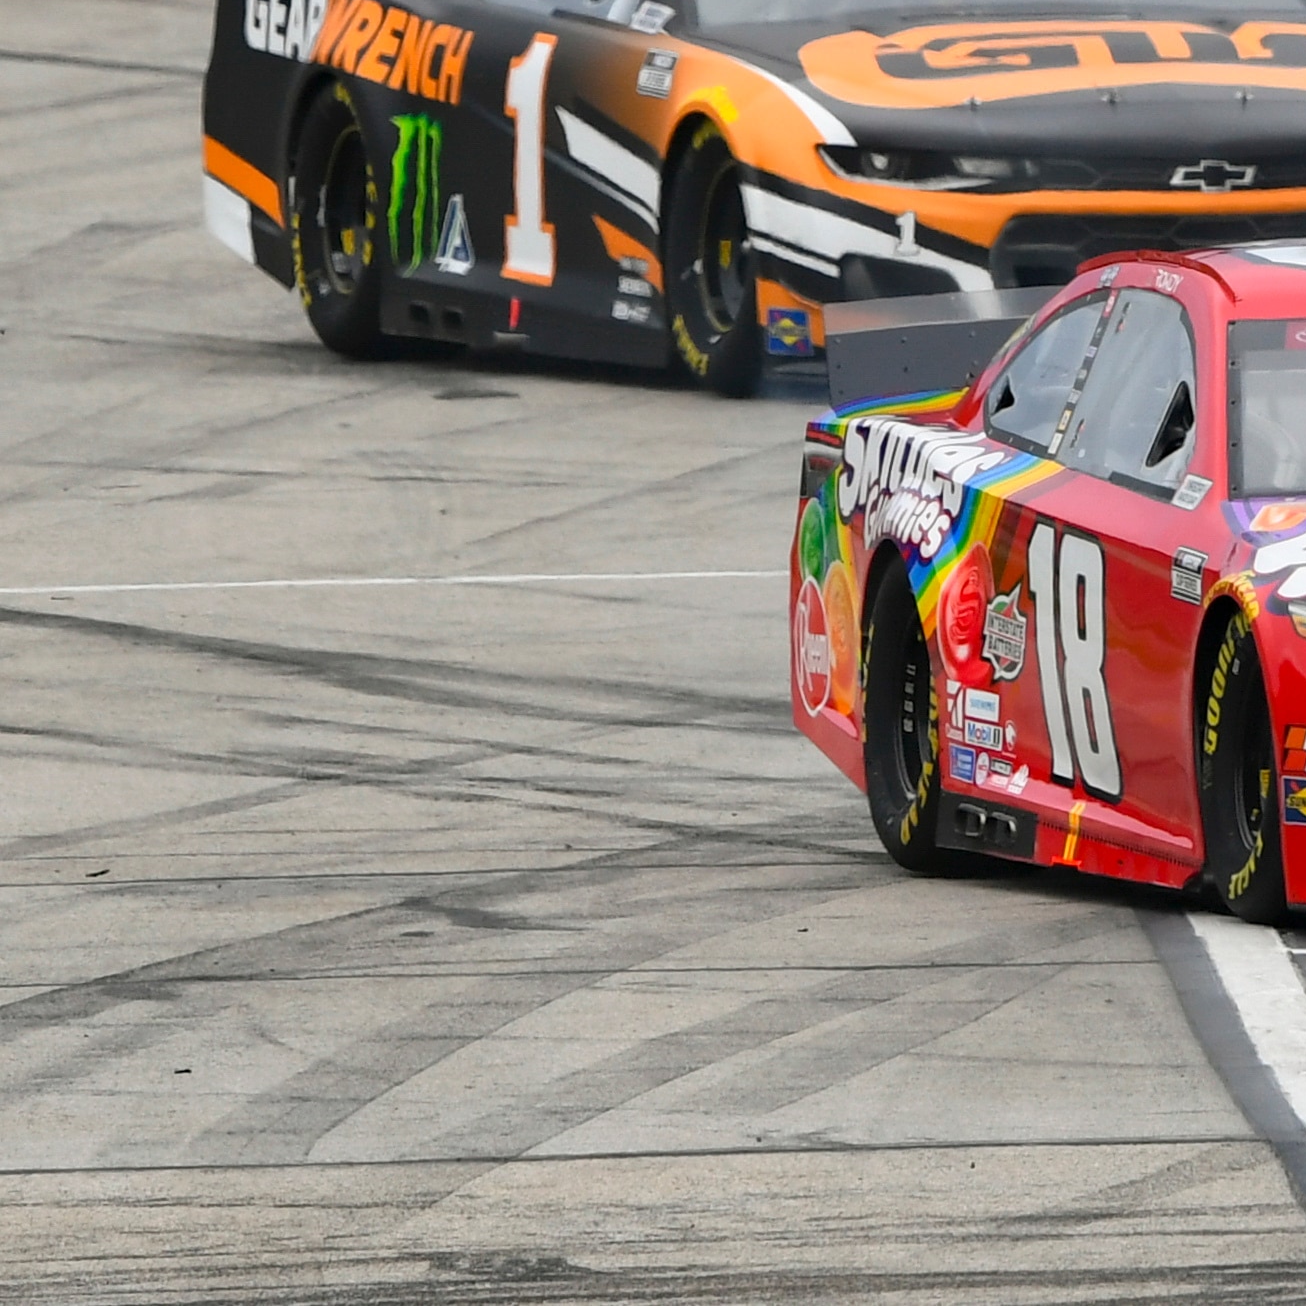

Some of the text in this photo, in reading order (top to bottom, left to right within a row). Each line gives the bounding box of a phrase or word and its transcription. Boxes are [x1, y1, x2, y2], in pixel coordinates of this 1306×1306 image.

[501, 31, 560, 287] 1
[892, 210, 921, 256] 1
[864, 483, 950, 560] Gummies
[986, 636, 1023, 662] BATTERIES
[987, 612, 1025, 643] INTERSTATE
[1026, 520, 1124, 804] 18
[966, 721, 992, 743] Mobil
